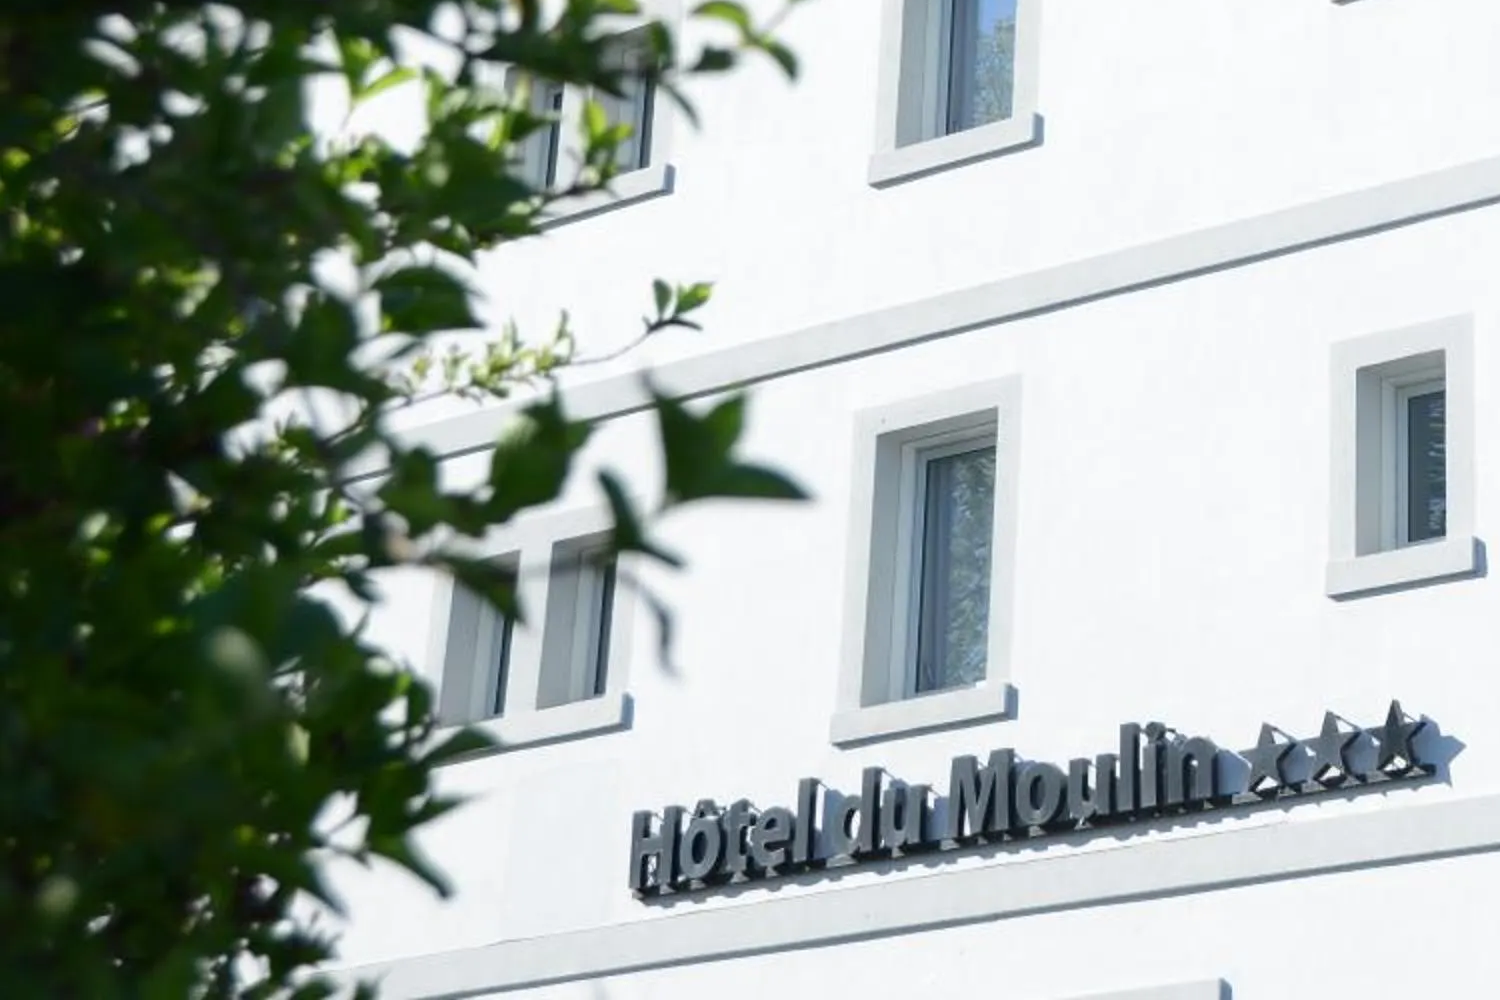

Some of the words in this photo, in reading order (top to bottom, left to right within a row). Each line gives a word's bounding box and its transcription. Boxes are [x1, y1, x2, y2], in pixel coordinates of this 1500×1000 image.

[629, 777, 820, 891] Hôtel
[836, 766, 931, 853] du
[948, 722, 1218, 840] Moulin
